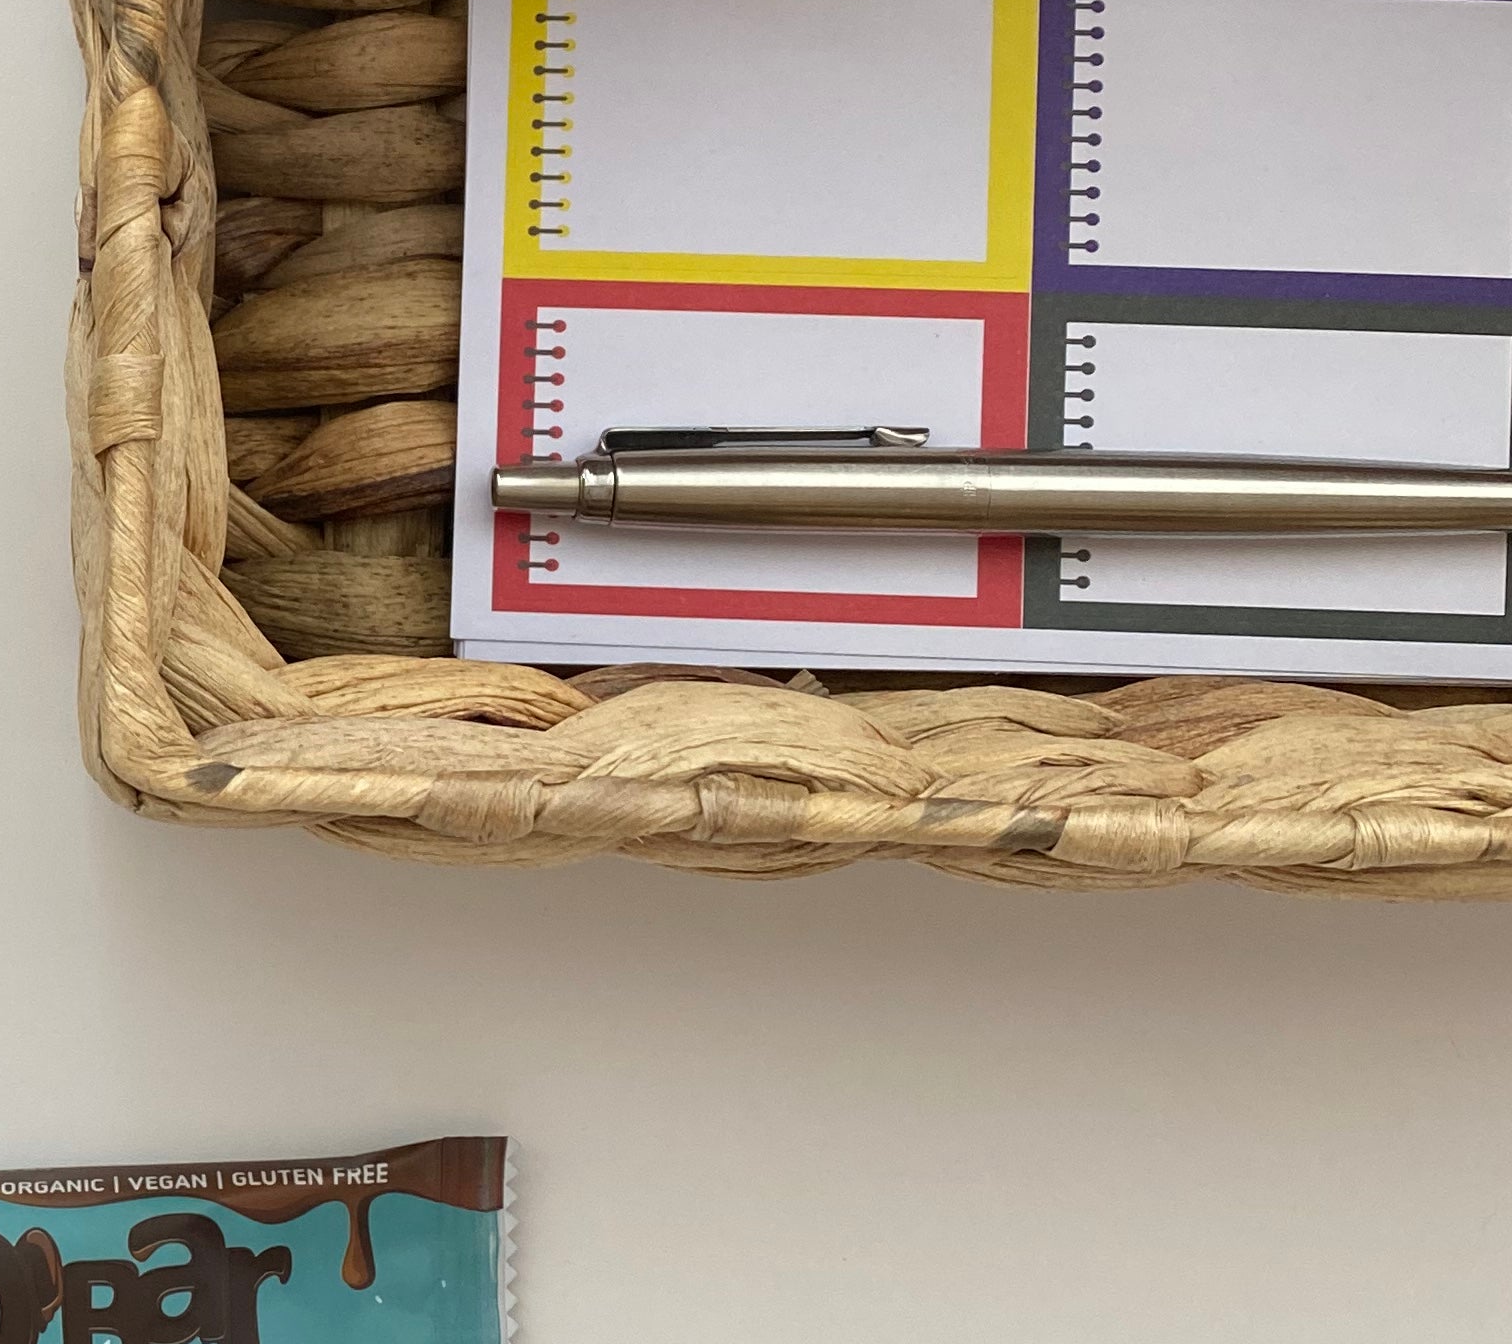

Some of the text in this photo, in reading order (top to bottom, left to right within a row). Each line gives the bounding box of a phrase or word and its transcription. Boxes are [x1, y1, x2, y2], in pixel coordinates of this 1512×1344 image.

[0, 1178, 105, 1195] ORGANIC
[128, 1174, 207, 1191] VEGAN
[231, 1168, 324, 1188] GLUTEN
[333, 1162, 389, 1185] FREE
